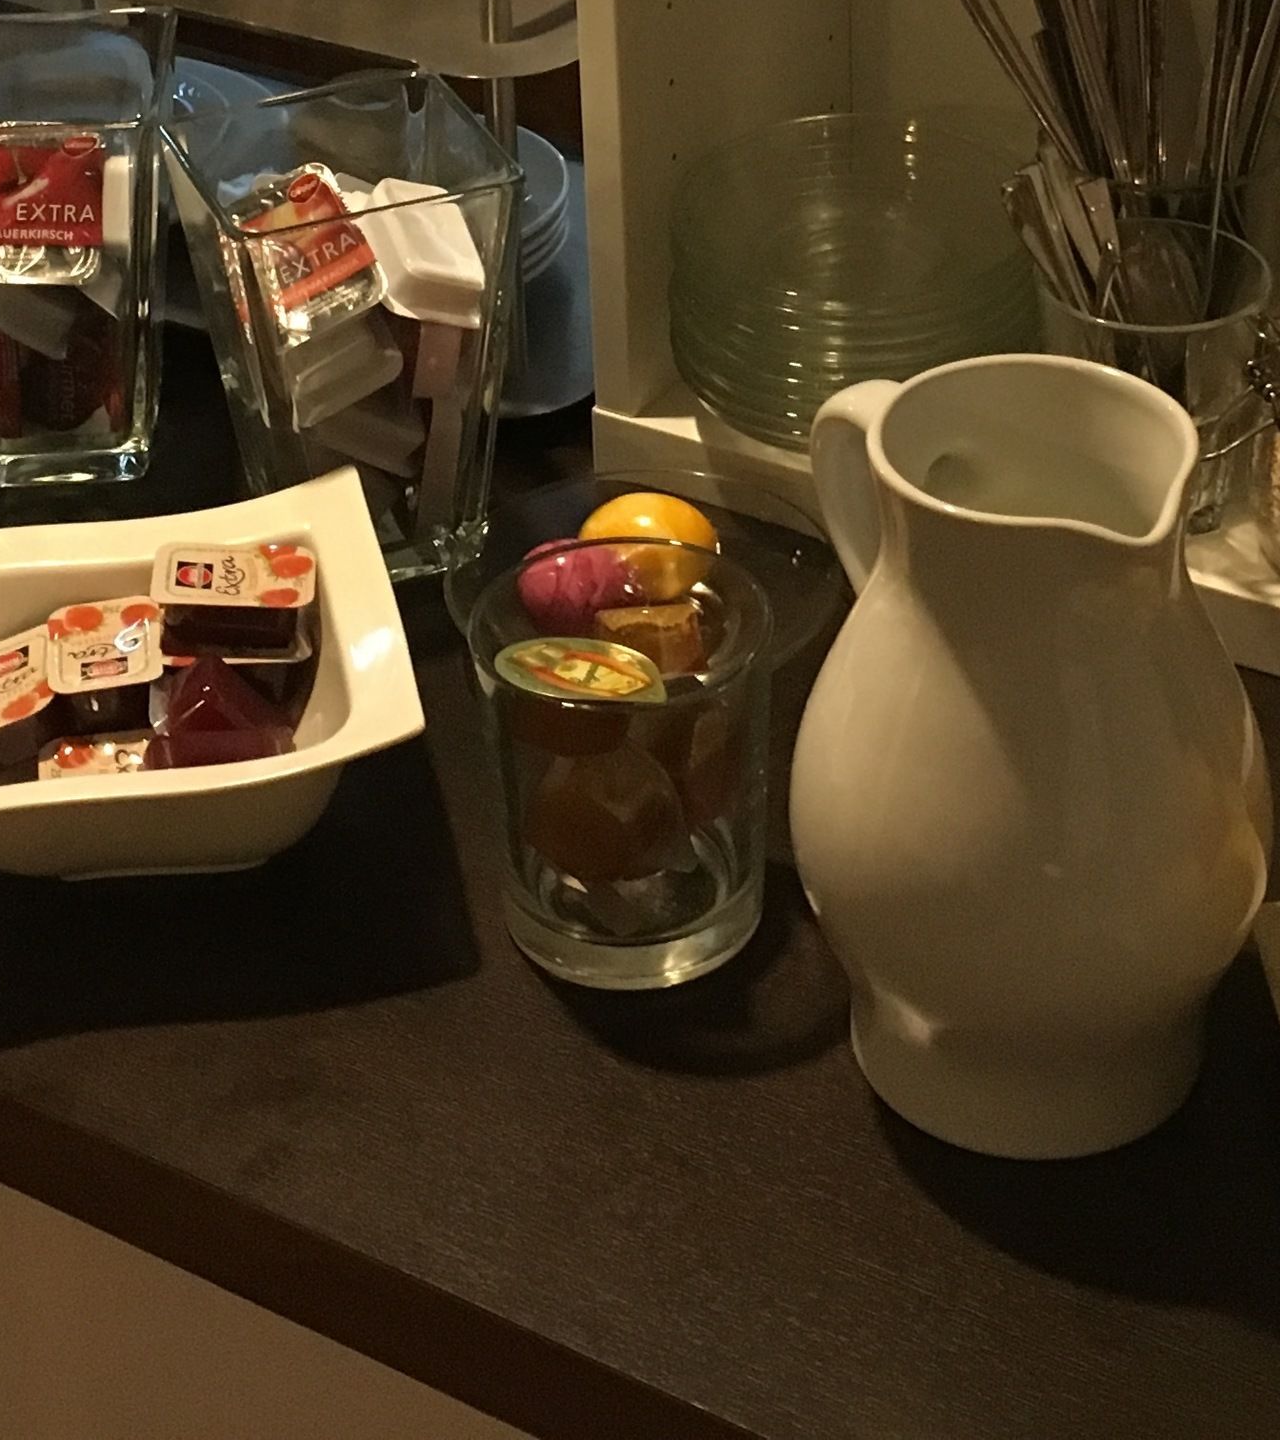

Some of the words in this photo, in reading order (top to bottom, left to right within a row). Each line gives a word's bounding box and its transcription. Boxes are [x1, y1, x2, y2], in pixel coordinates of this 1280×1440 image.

[16, 203, 95, 222] EXTRA
[280, 233, 357, 284] EXTRA
[216, 555, 246, 596] Extra
